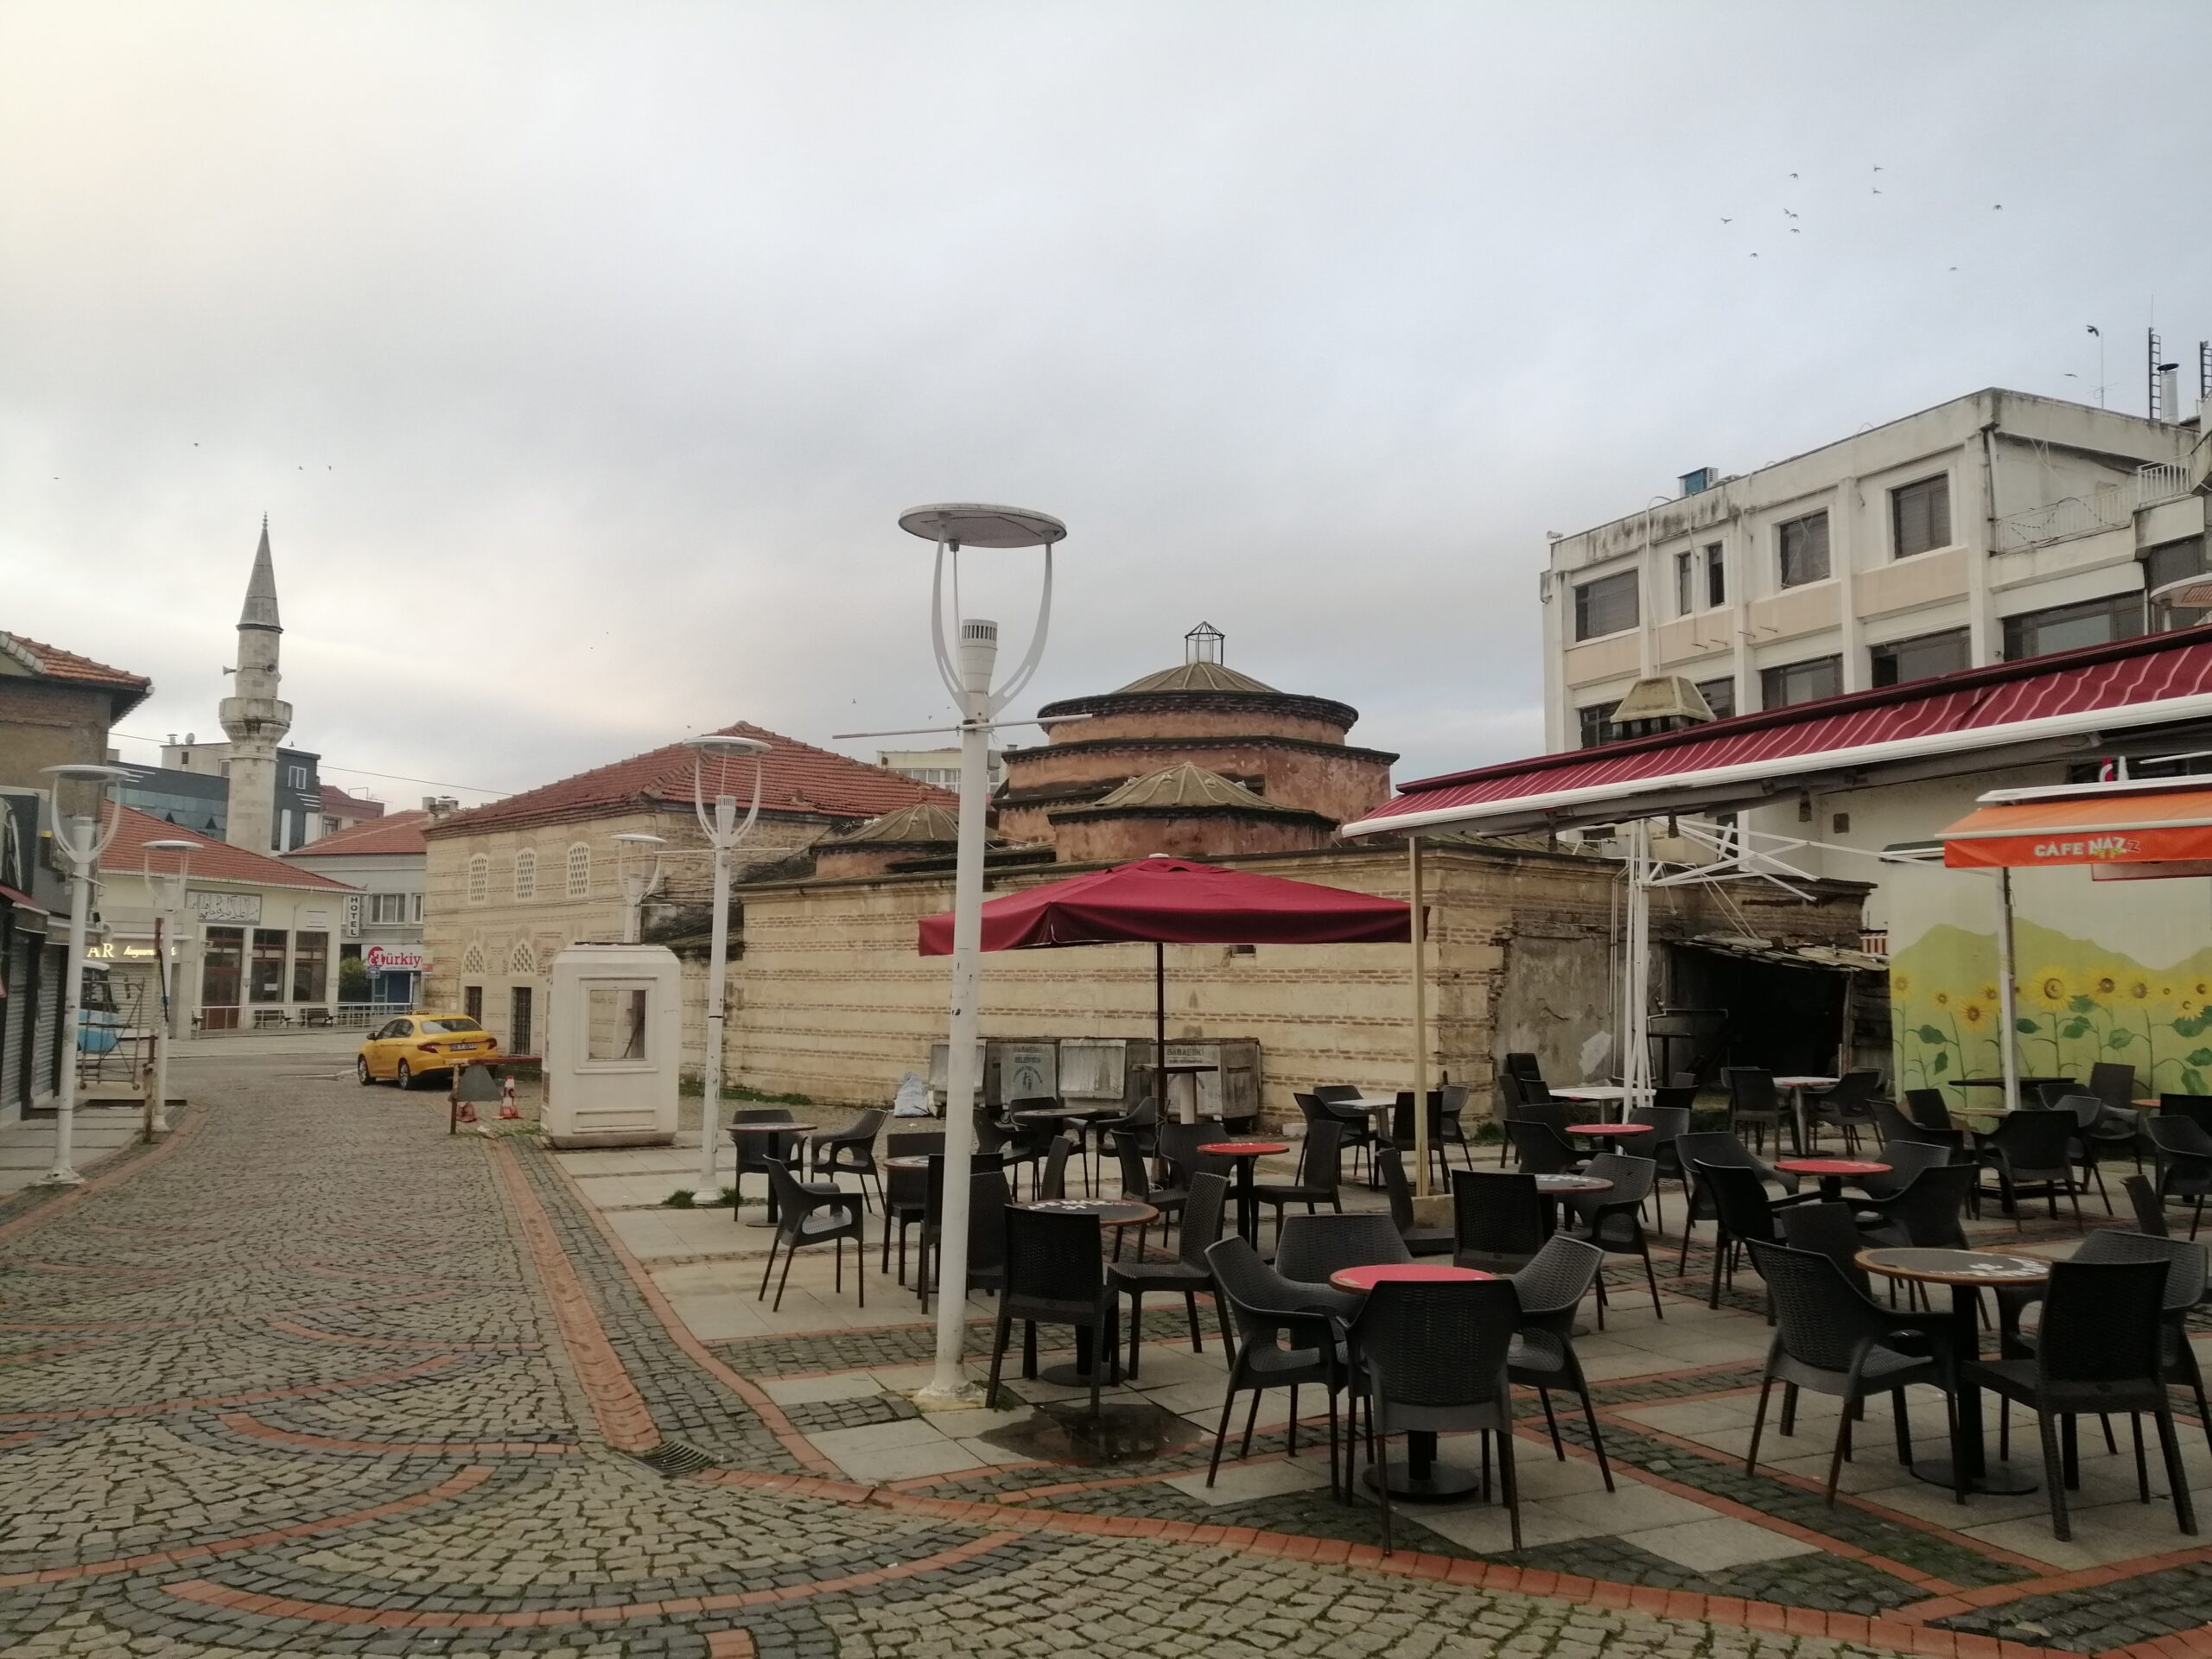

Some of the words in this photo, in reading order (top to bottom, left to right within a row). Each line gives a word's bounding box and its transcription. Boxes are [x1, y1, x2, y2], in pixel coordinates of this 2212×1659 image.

[2035, 842, 2084, 856] CAFE
[350, 897, 359, 936] HOTEL
[86, 943, 114, 958] AR
[371, 949, 423, 969] Türkiy
